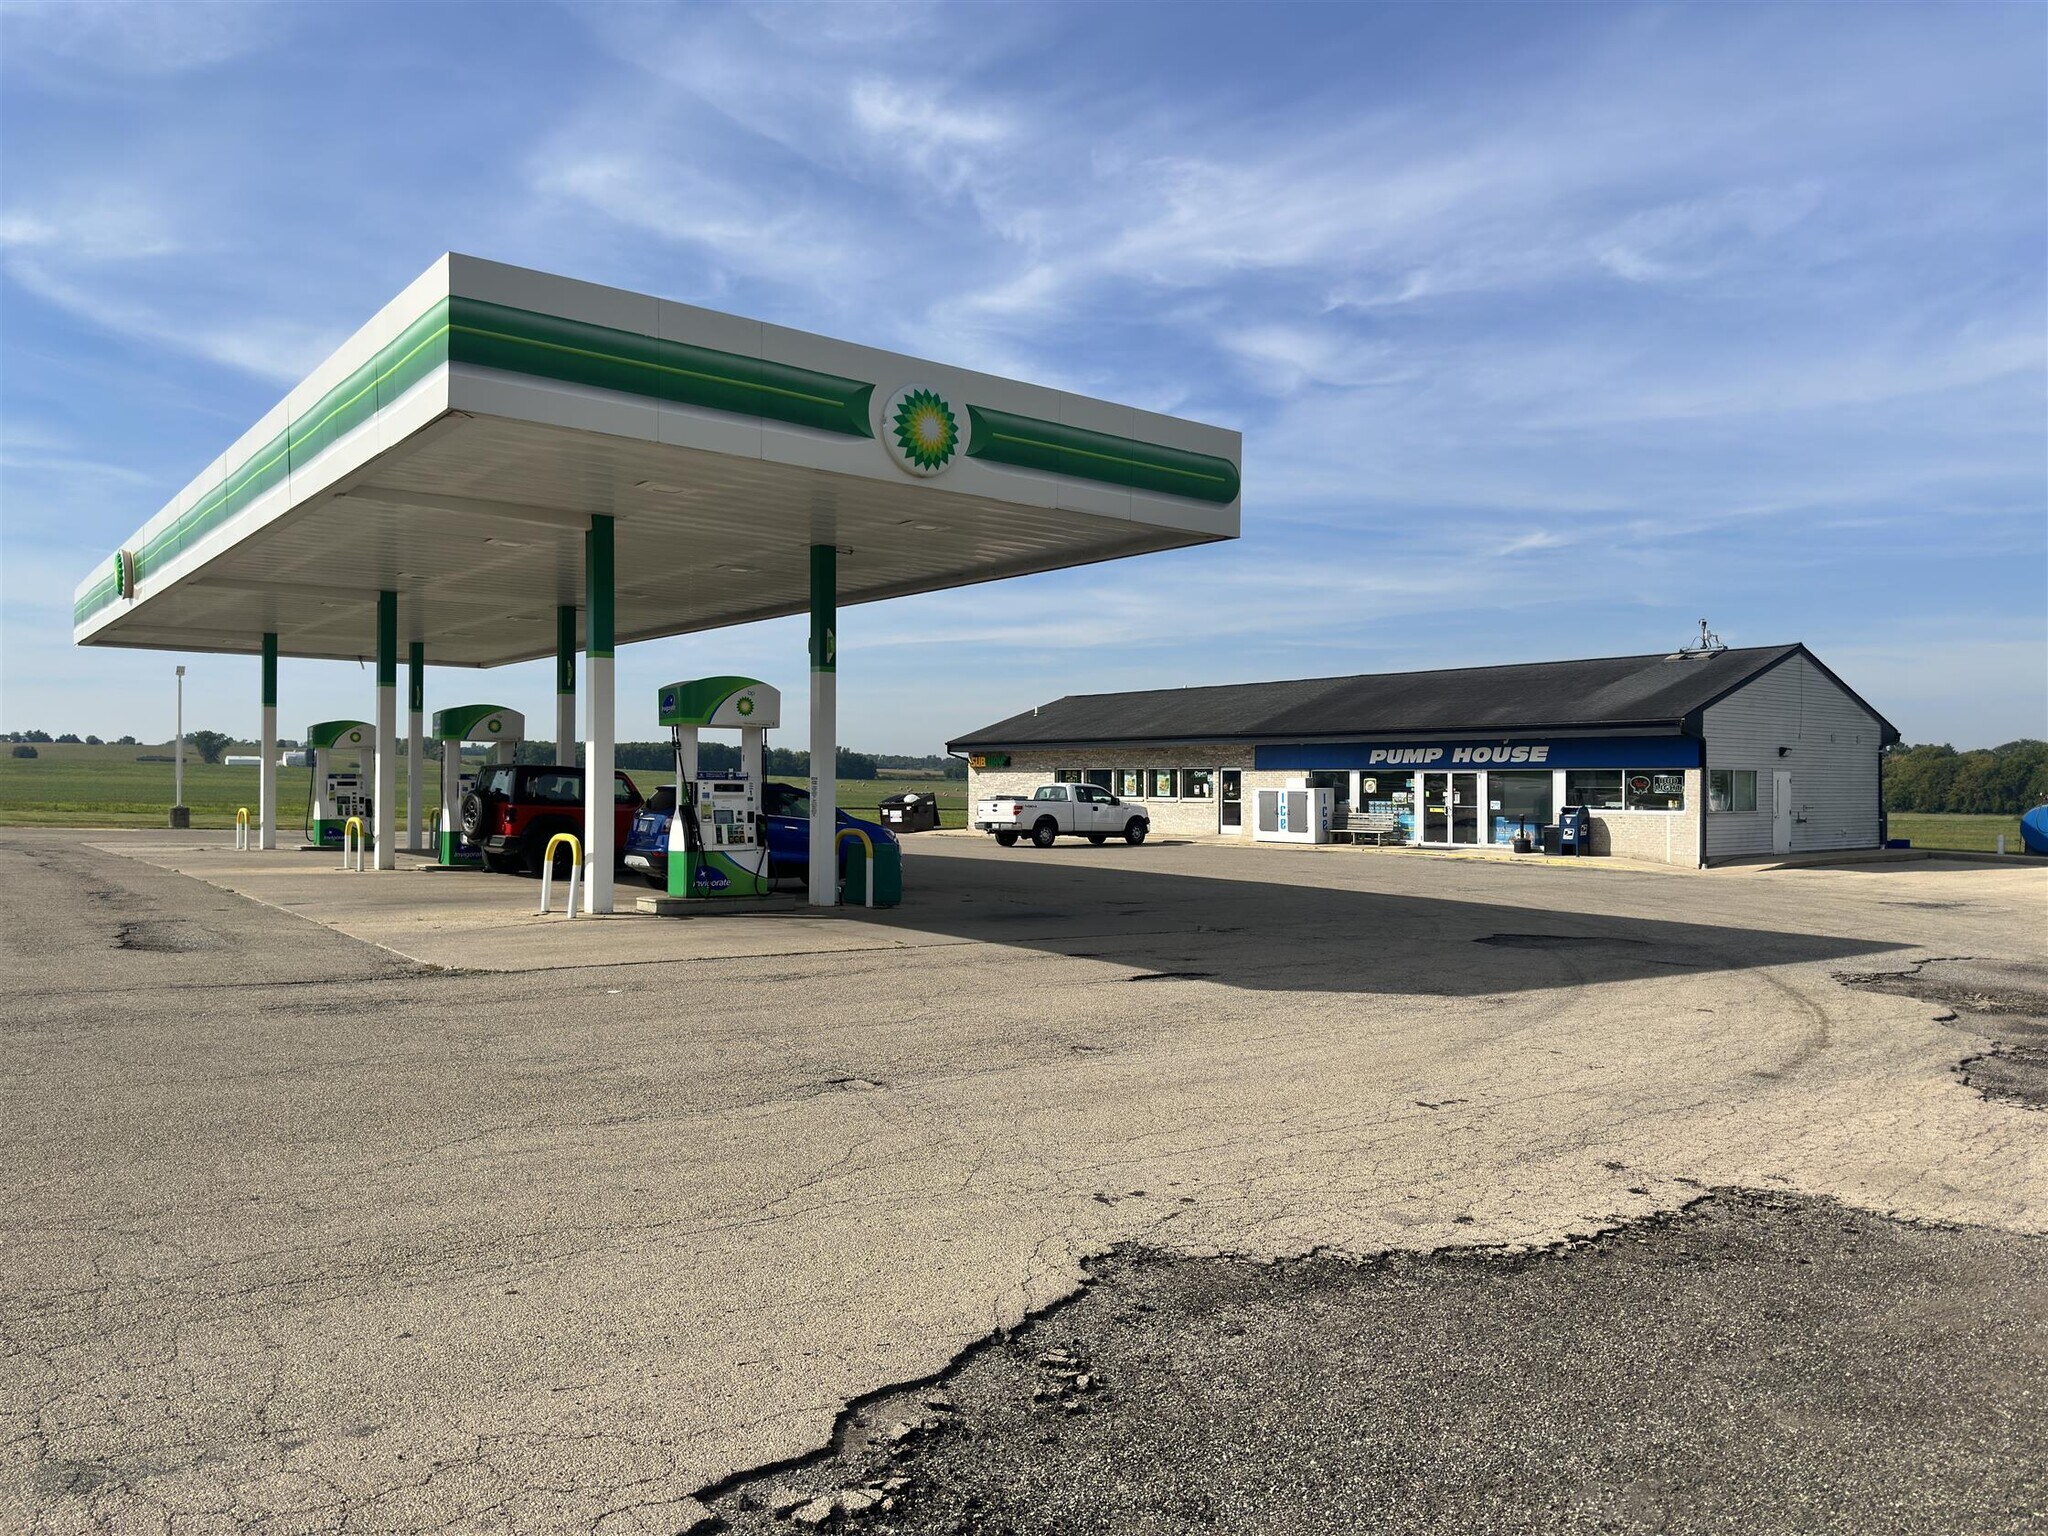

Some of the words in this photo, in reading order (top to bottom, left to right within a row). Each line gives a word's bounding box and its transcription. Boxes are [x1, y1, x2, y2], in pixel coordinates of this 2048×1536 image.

[1369, 747, 1443, 764] PUMP
[1452, 745, 1550, 763] HOUSE
[1654, 783, 1683, 792] LIGHT
